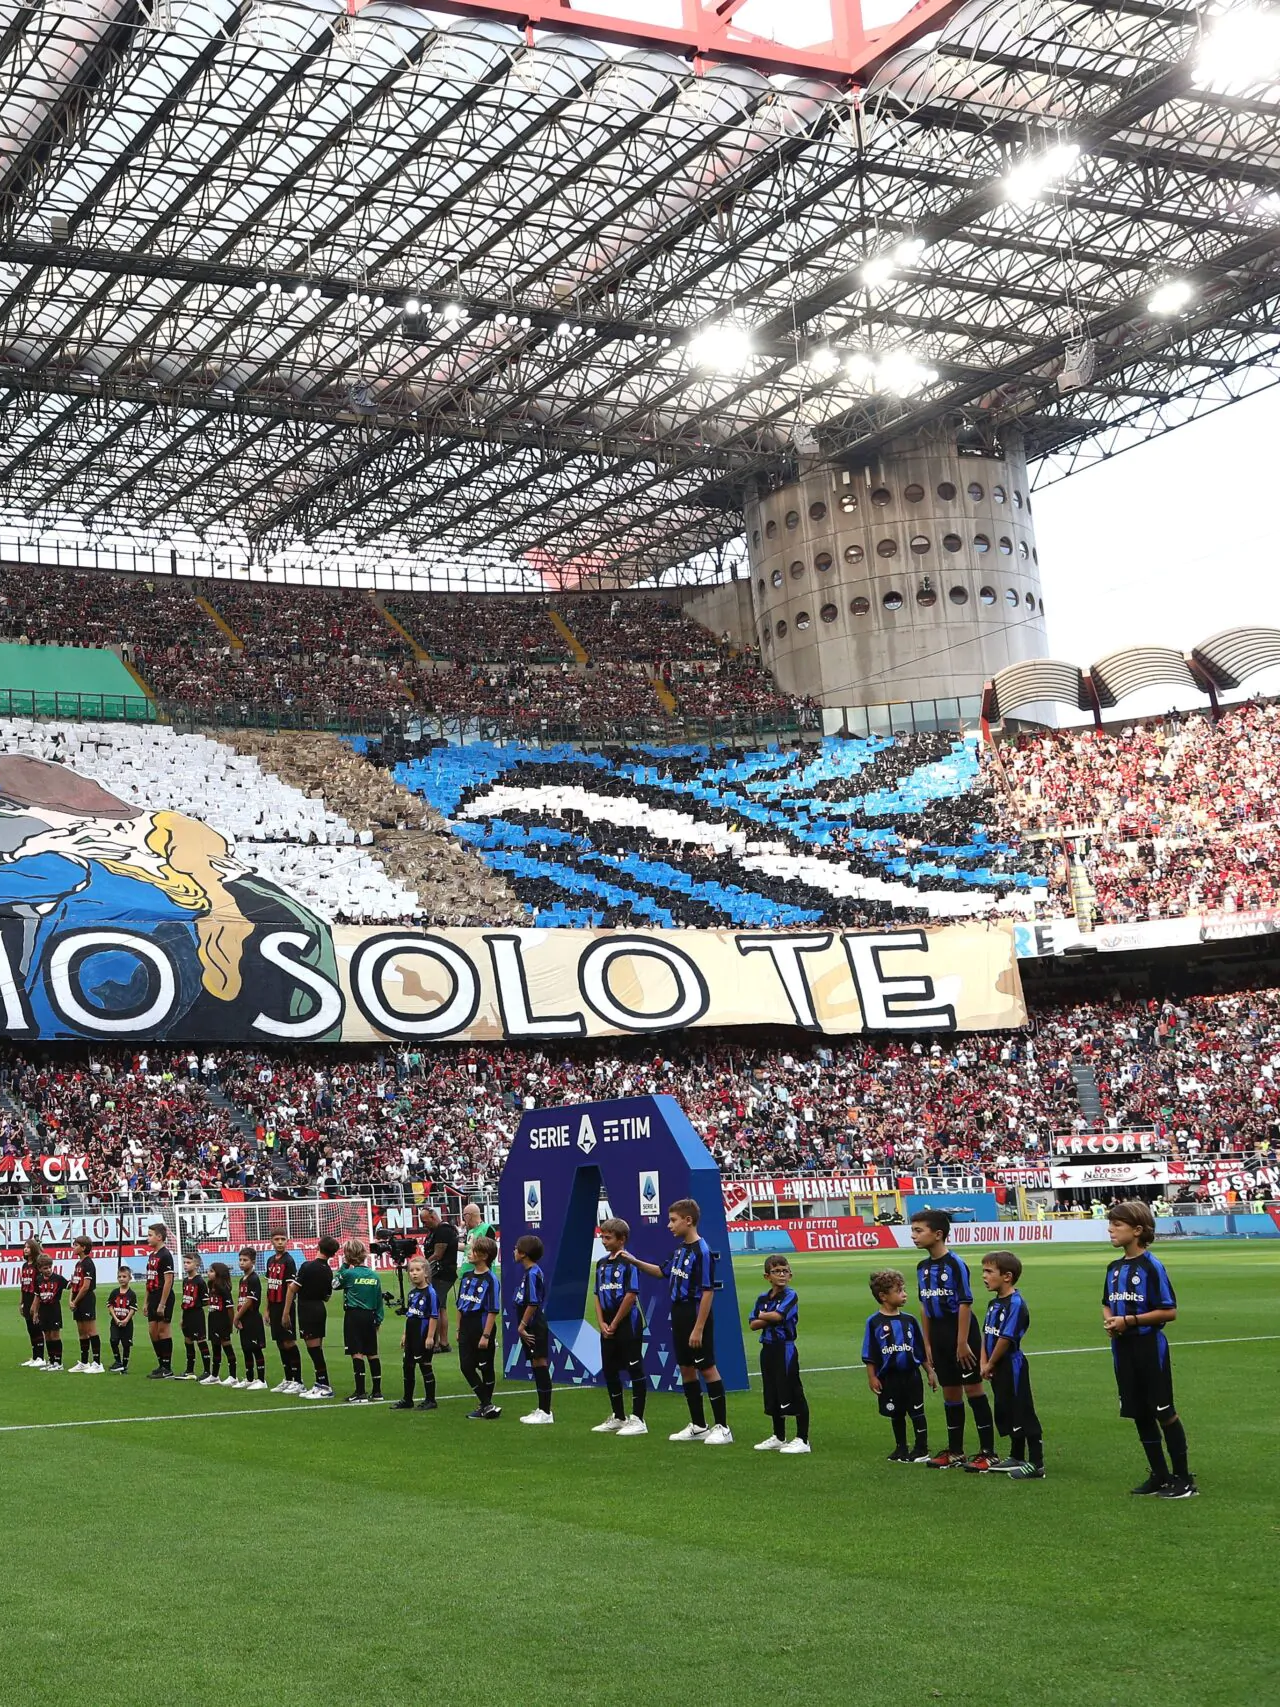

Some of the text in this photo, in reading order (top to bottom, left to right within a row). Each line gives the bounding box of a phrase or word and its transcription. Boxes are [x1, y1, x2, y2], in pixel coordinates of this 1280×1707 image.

[530, 1125, 570, 1149] SERIE
[621, 1116, 651, 1140] TIM
[1094, 1166, 1131, 1174] Rosso
[783, 1177, 890, 1201] #WEAREACMILAN
[916, 1177, 983, 1190] DESIO
[807, 1231, 879, 1250] Emirates
[954, 1226, 970, 1243] YOU
[974, 1226, 1000, 1242] SOON
[1003, 1226, 1015, 1241] IN
[1020, 1225, 1053, 1241] DUBAI
